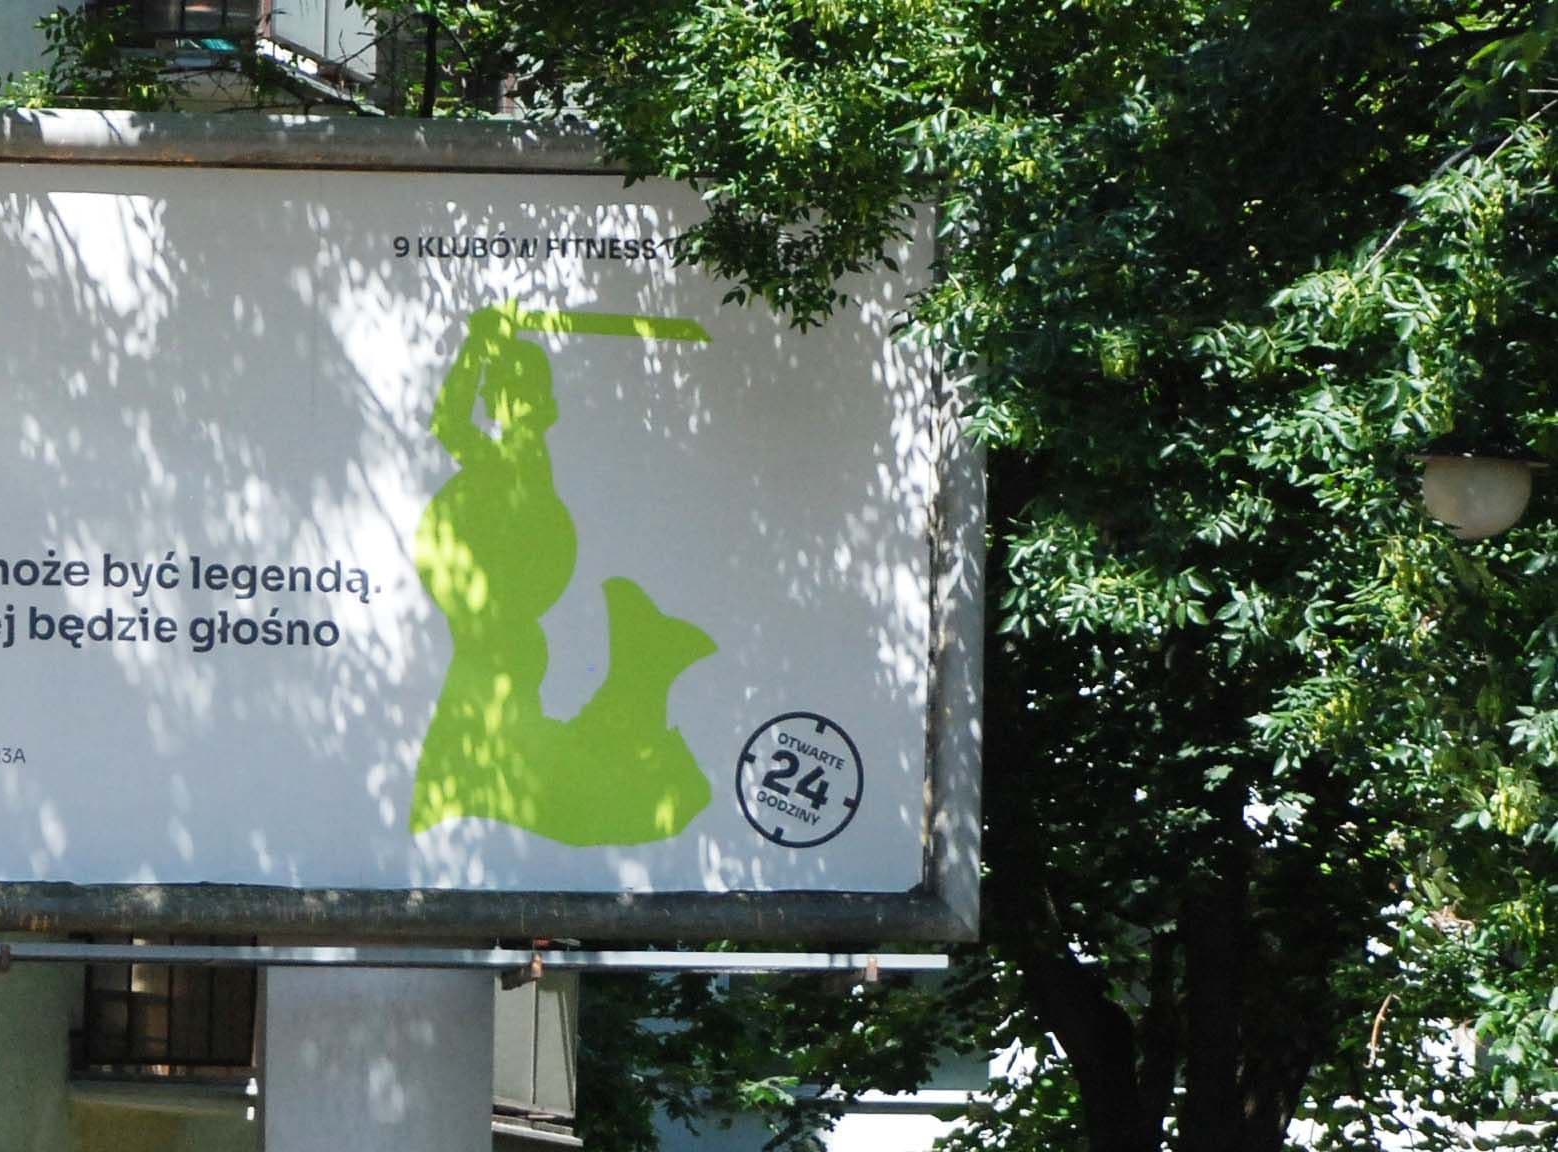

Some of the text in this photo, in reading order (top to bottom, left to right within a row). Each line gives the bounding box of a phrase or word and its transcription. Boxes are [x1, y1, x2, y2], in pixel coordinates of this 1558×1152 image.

[392, 236, 410, 258] 9
[417, 231, 538, 259] KLUBÓW
[545, 237, 657, 260] FITNESS
[103, 551, 180, 597] być
[190, 556, 382, 604] legendą.
[29, 606, 179, 649] będzie
[189, 607, 341, 653] głośno
[777, 732, 845, 771] OTWARTE
[762, 749, 830, 811] 24
[756, 790, 821, 826] GODZINY
